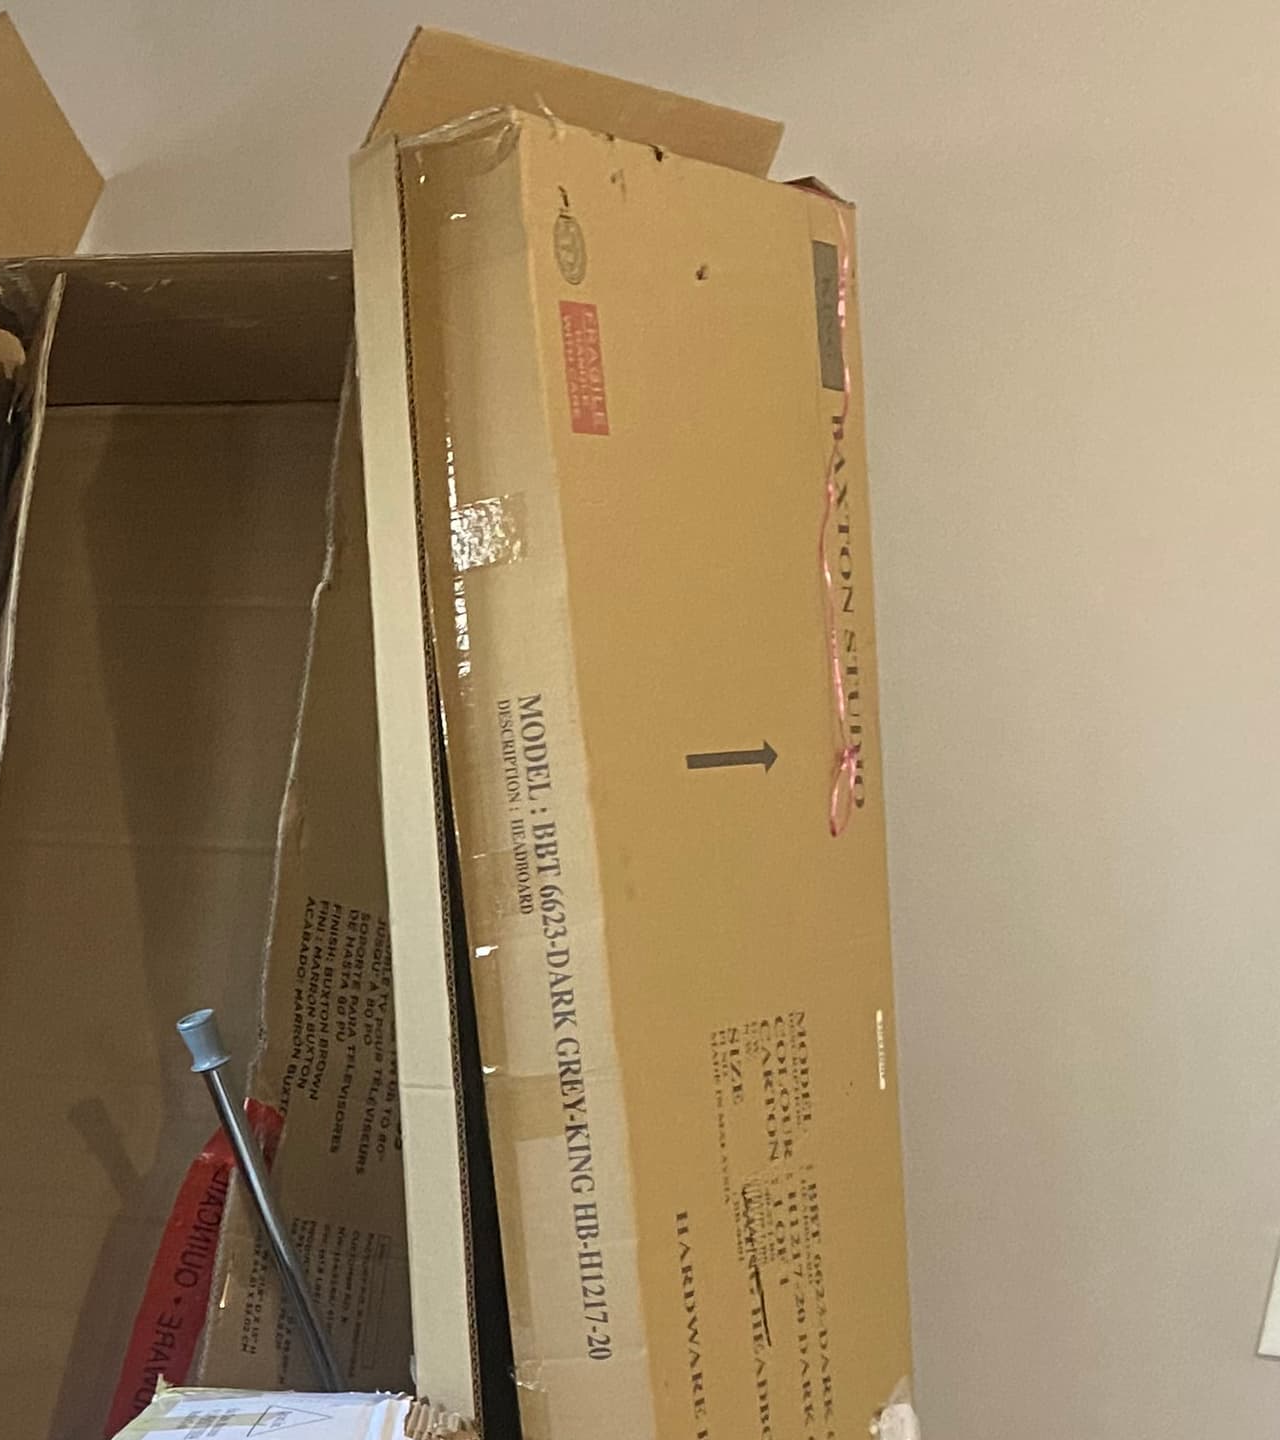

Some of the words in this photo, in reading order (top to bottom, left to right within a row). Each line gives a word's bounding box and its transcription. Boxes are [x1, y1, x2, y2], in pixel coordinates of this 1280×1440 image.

[583, 310, 607, 424] FRAGILE
[519, 694, 551, 801] MODEL
[497, 700, 522, 804] DESCRIPTION
[512, 819, 535, 914] HEADBOARD
[531, 821, 561, 882] BBT
[317, 900, 329, 932] FINI
[340, 936, 356, 989] HASTA
[348, 909, 359, 932] DE
[540, 882, 577, 1028] 6623-DARK
[320, 967, 334, 1033] BUXTON
[347, 995, 359, 1038] PARA
[296, 1022, 315, 1090] BUXTON
[310, 1038, 328, 1100] BROWN
[760, 1020, 779, 1161] CARTON
[775, 1015, 793, 1159] COLOUR
[552, 1037, 595, 1194] GREY-KING
[573, 1203, 612, 1361] HB-H1217-20
[675, 1210, 707, 1421] HARDWARE
